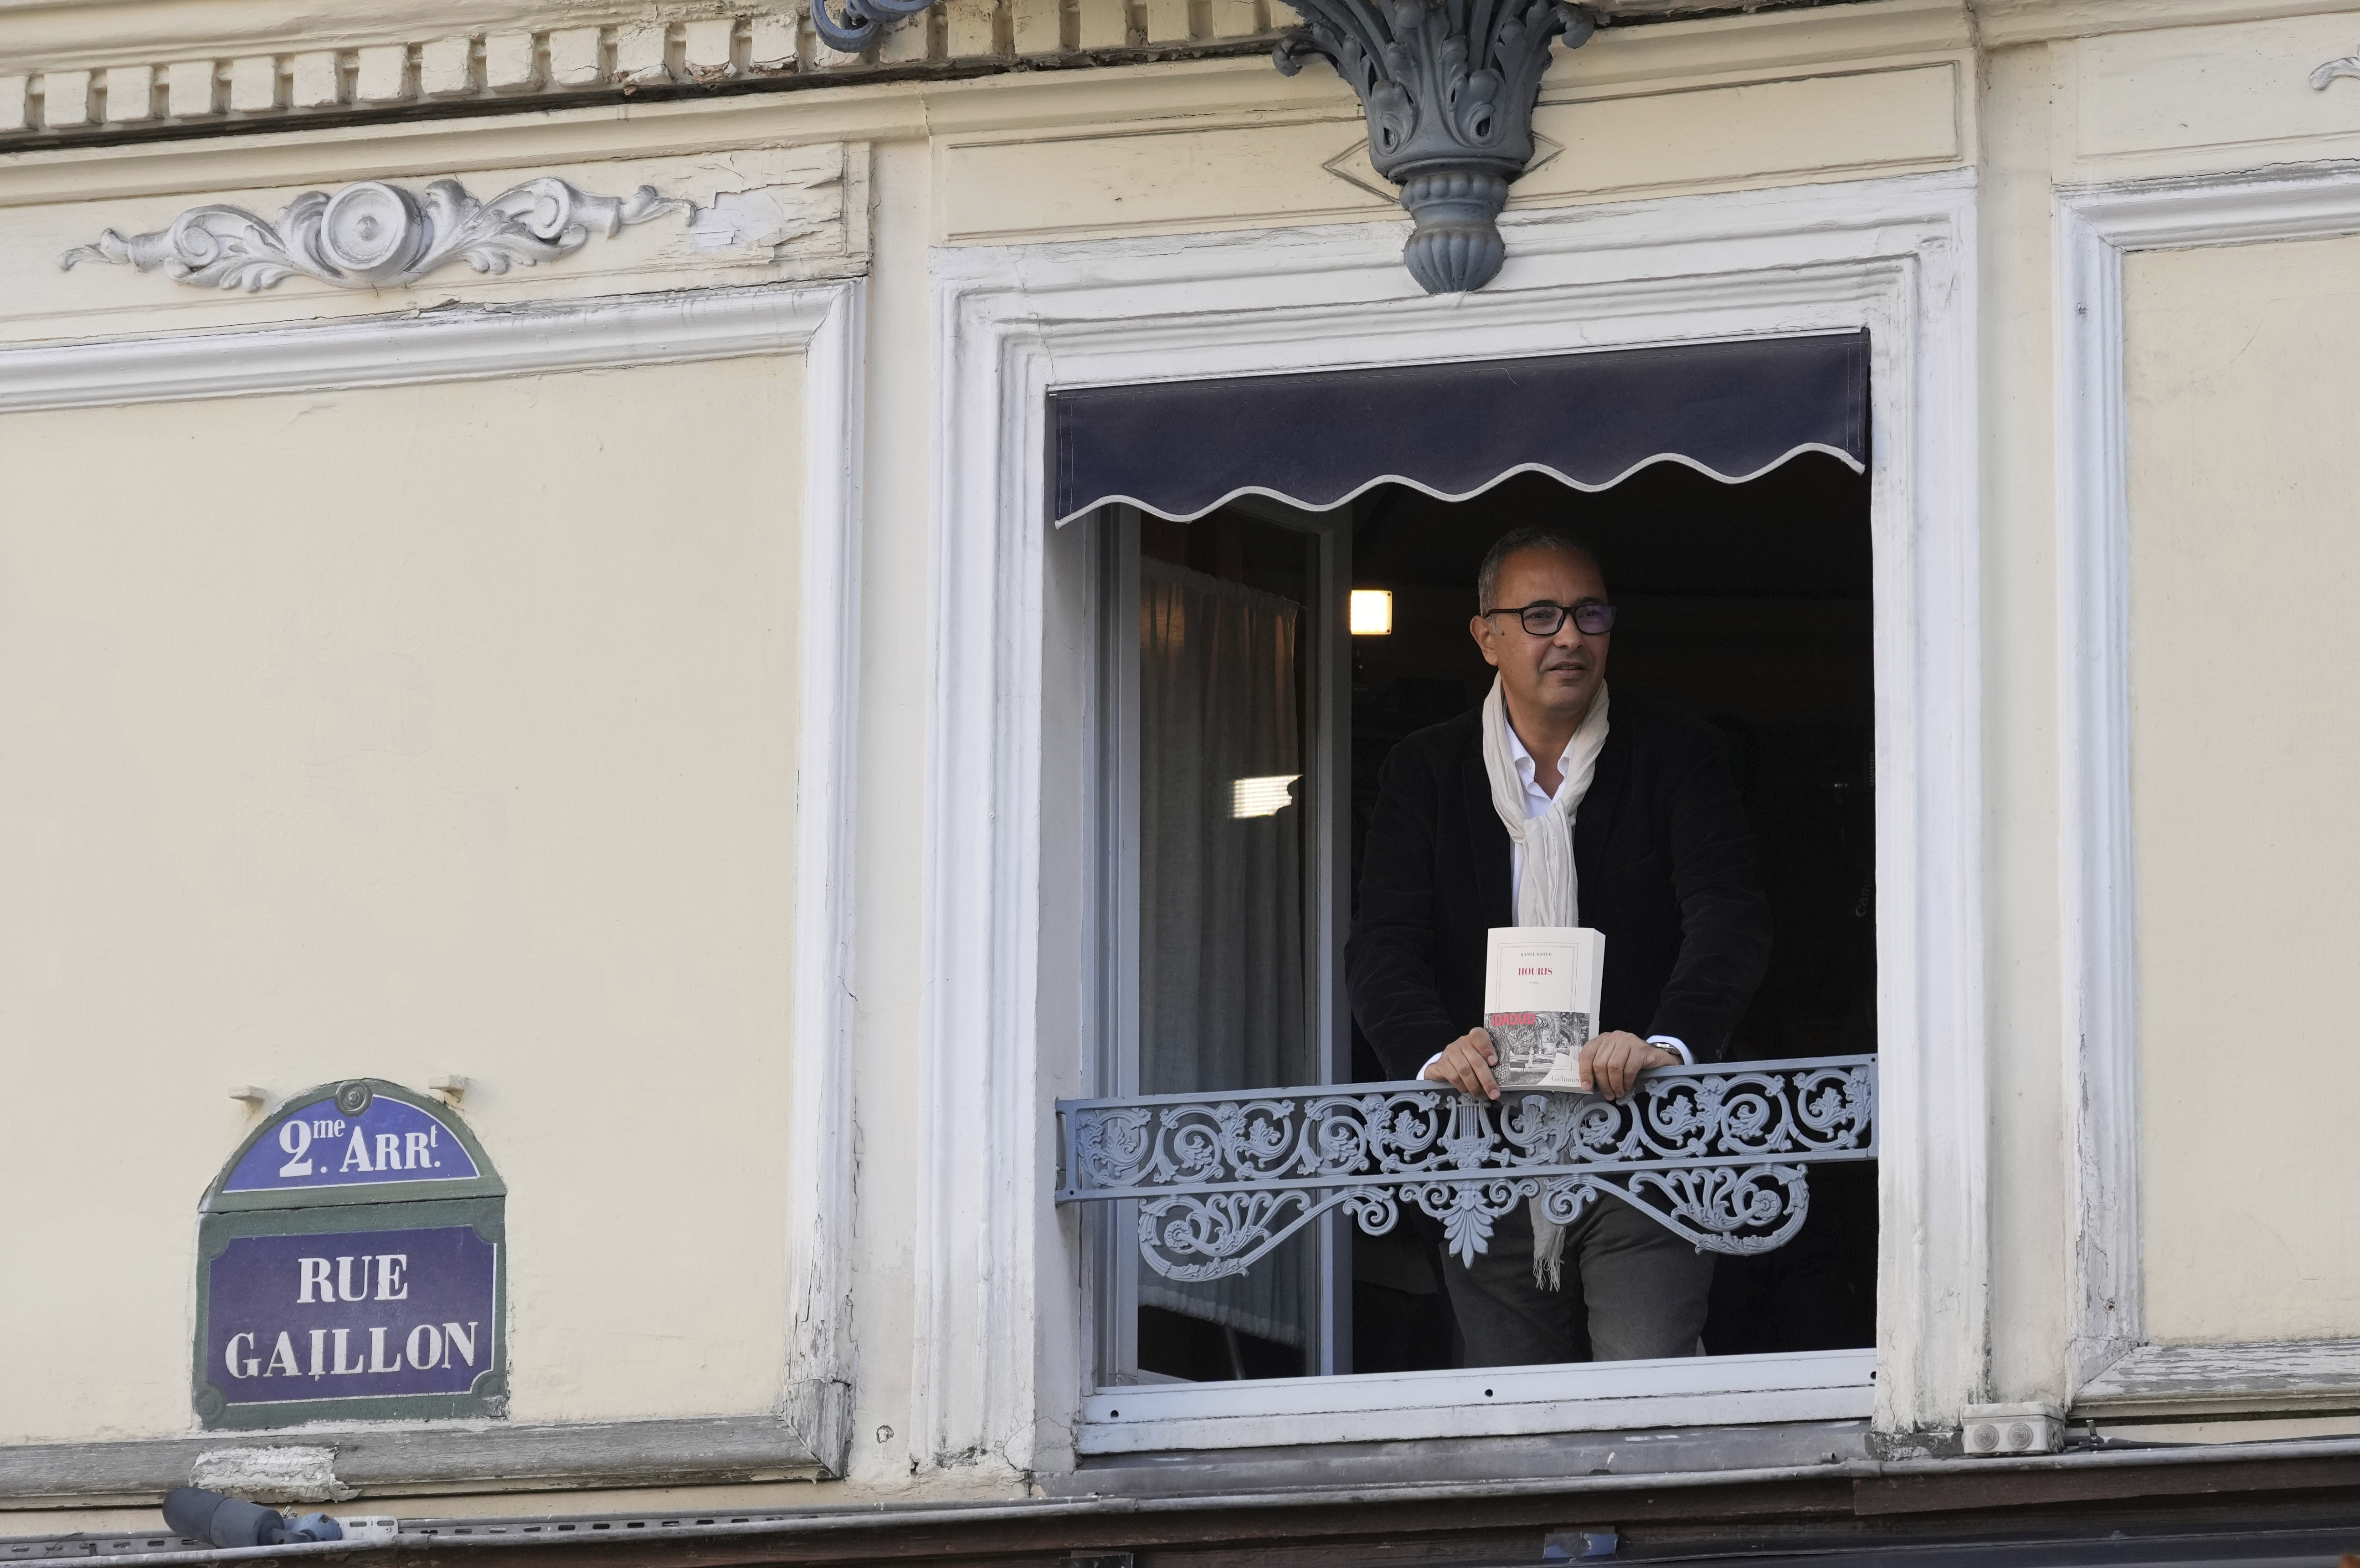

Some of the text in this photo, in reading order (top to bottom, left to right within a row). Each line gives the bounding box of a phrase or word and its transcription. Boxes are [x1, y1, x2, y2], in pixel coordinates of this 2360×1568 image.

[1518, 967, 1553, 975] HOURIS
[1494, 1013, 1536, 1026] DAOUD
[296, 1254, 408, 1303] RUE
[225, 1322, 478, 1378] GAILLON
